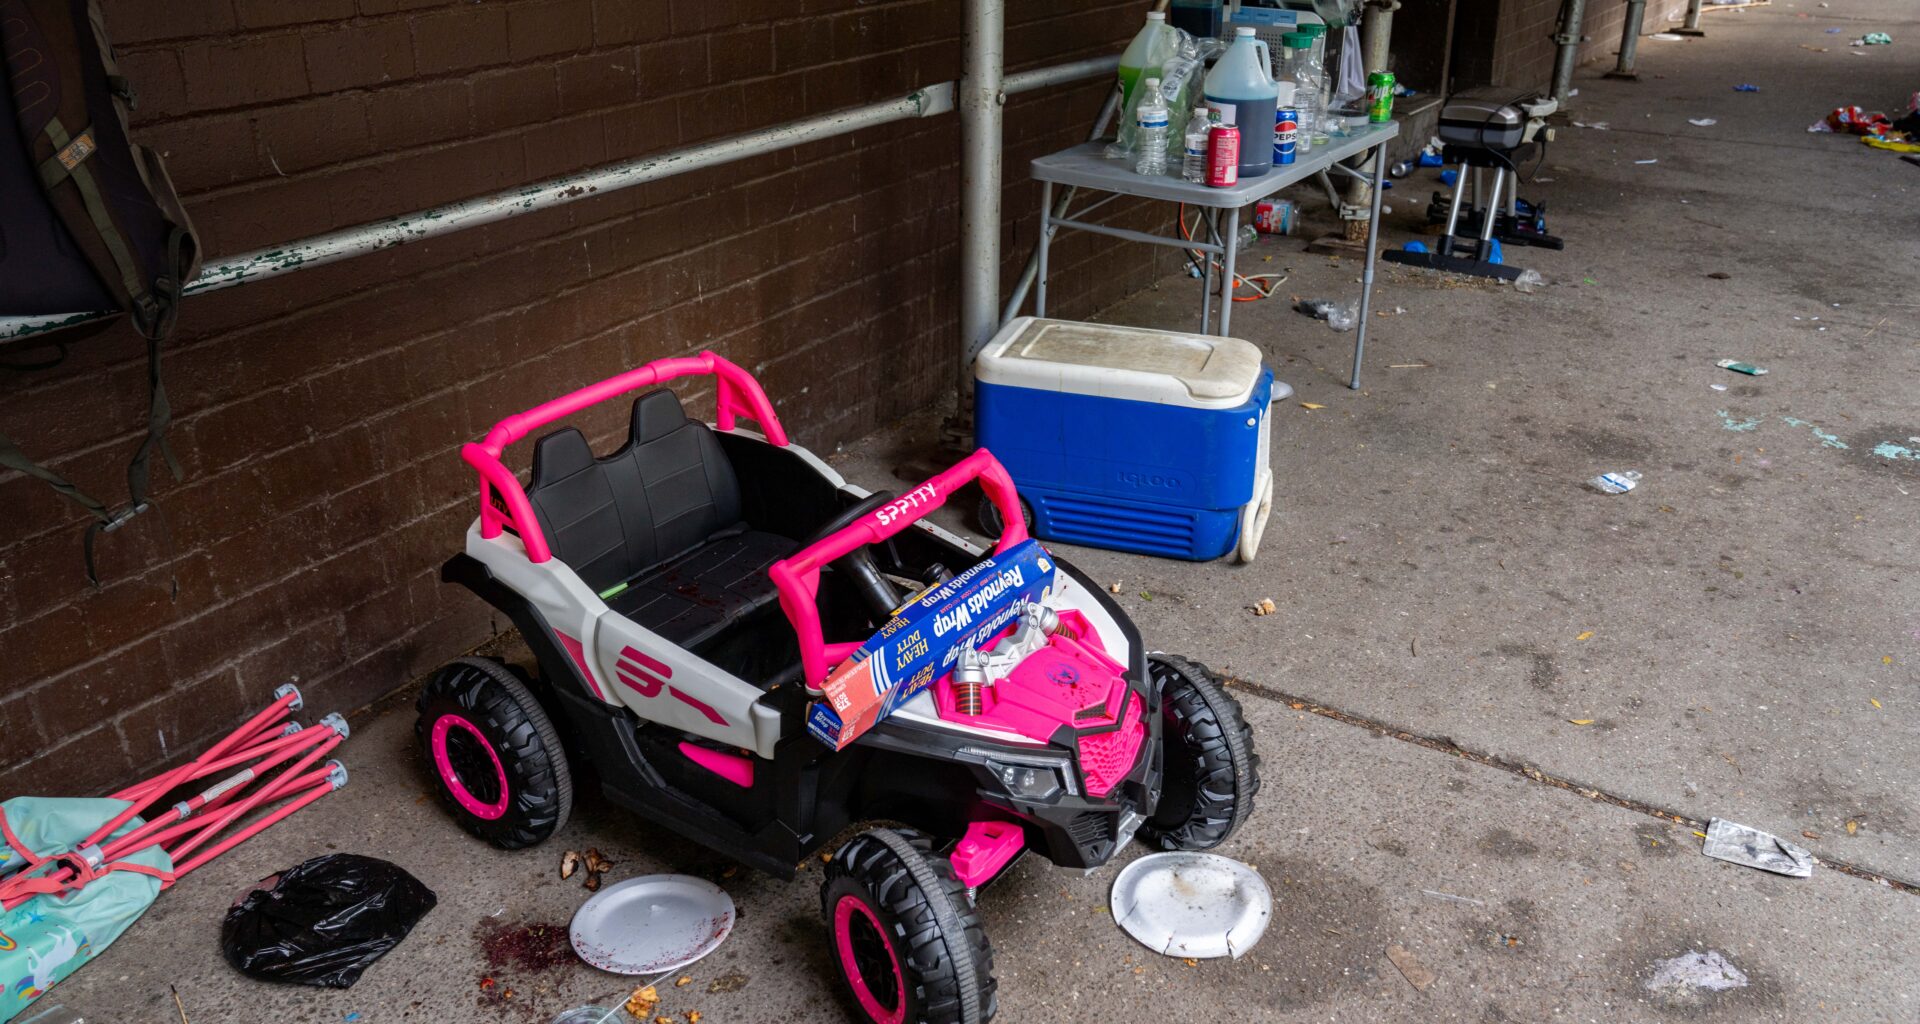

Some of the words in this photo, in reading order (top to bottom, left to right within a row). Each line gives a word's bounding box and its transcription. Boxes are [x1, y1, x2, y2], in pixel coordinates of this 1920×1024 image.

[1273, 133, 1296, 141] PEPS
[948, 559, 996, 589] Reynolds
[921, 587, 956, 607] Wrap
[968, 565, 1024, 614] Reynolds
[882, 618, 910, 639] HEAVY
[934, 603, 972, 637] Wrap
[897, 630, 920, 654] DUTY
[897, 638, 929, 671] HEAVY
[900, 669, 935, 701] HEAVY
[836, 697, 852, 712] 375
